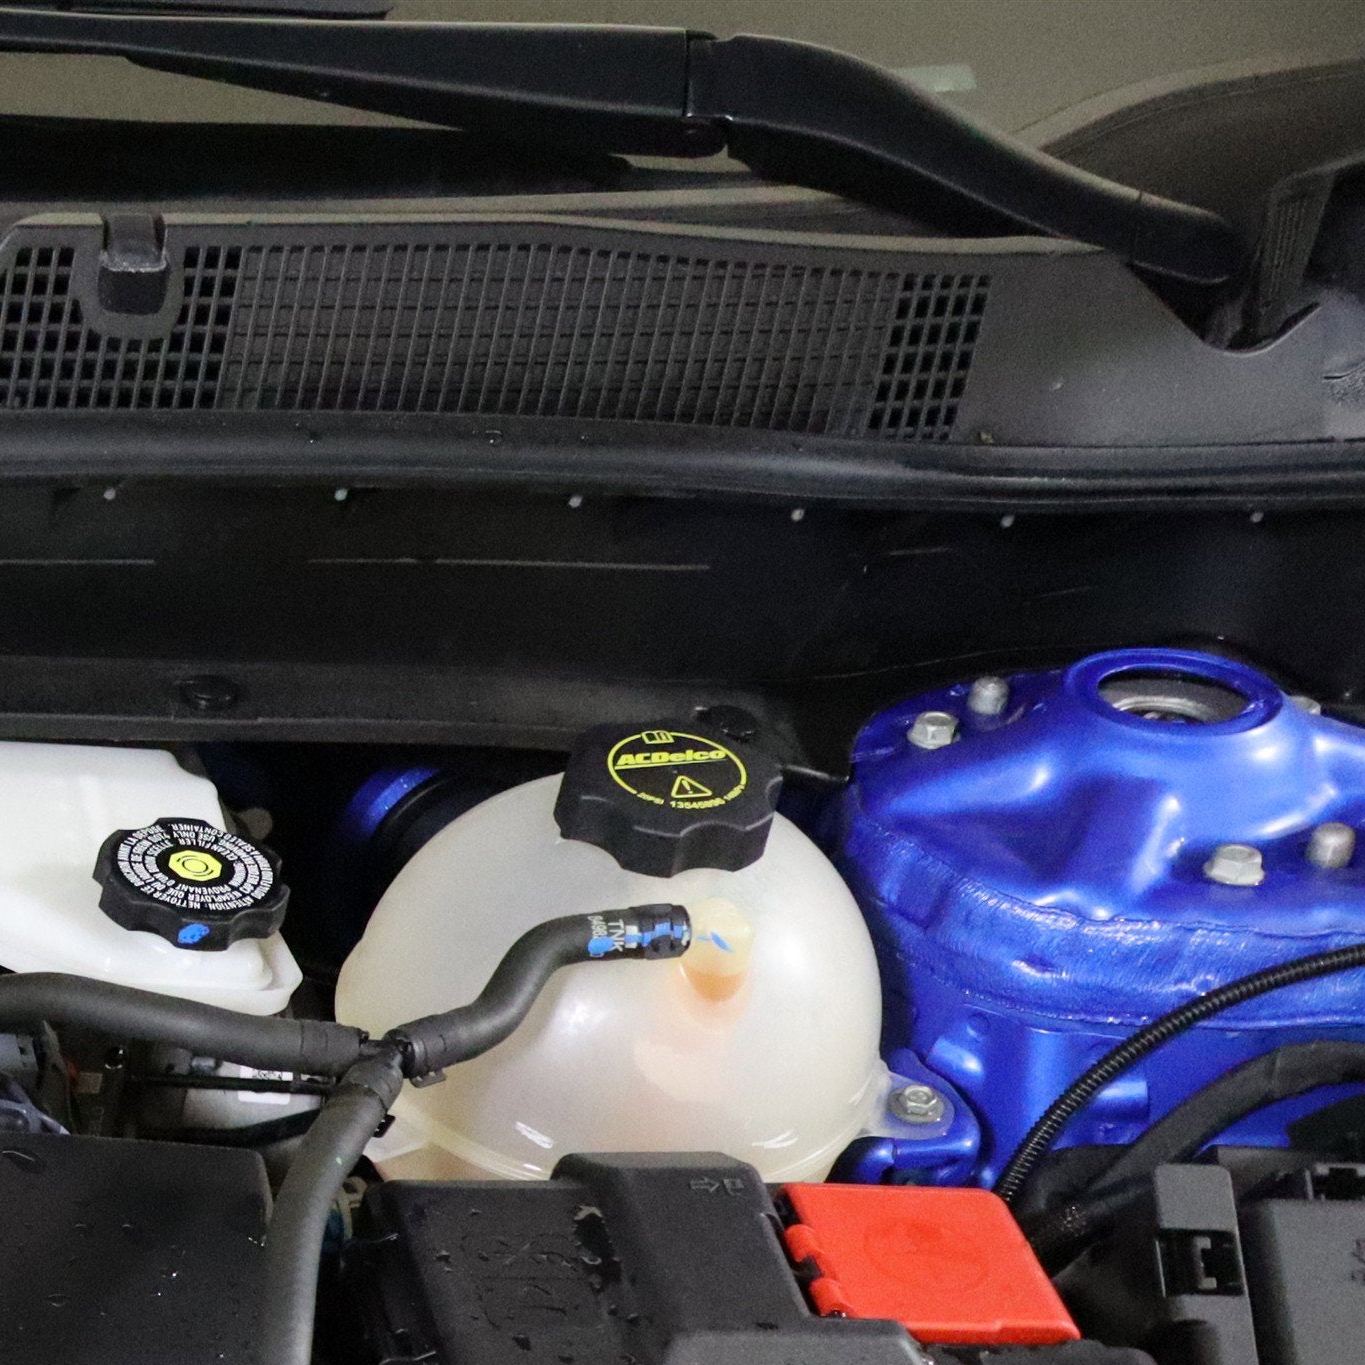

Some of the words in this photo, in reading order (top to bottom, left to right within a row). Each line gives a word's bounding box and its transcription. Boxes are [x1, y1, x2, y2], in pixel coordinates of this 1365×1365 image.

[616, 749, 727, 766] ACDelco
[170, 831, 195, 839] ONLY
[173, 882, 234, 895] PROVENANT
[150, 890, 201, 909] NETTOYER
